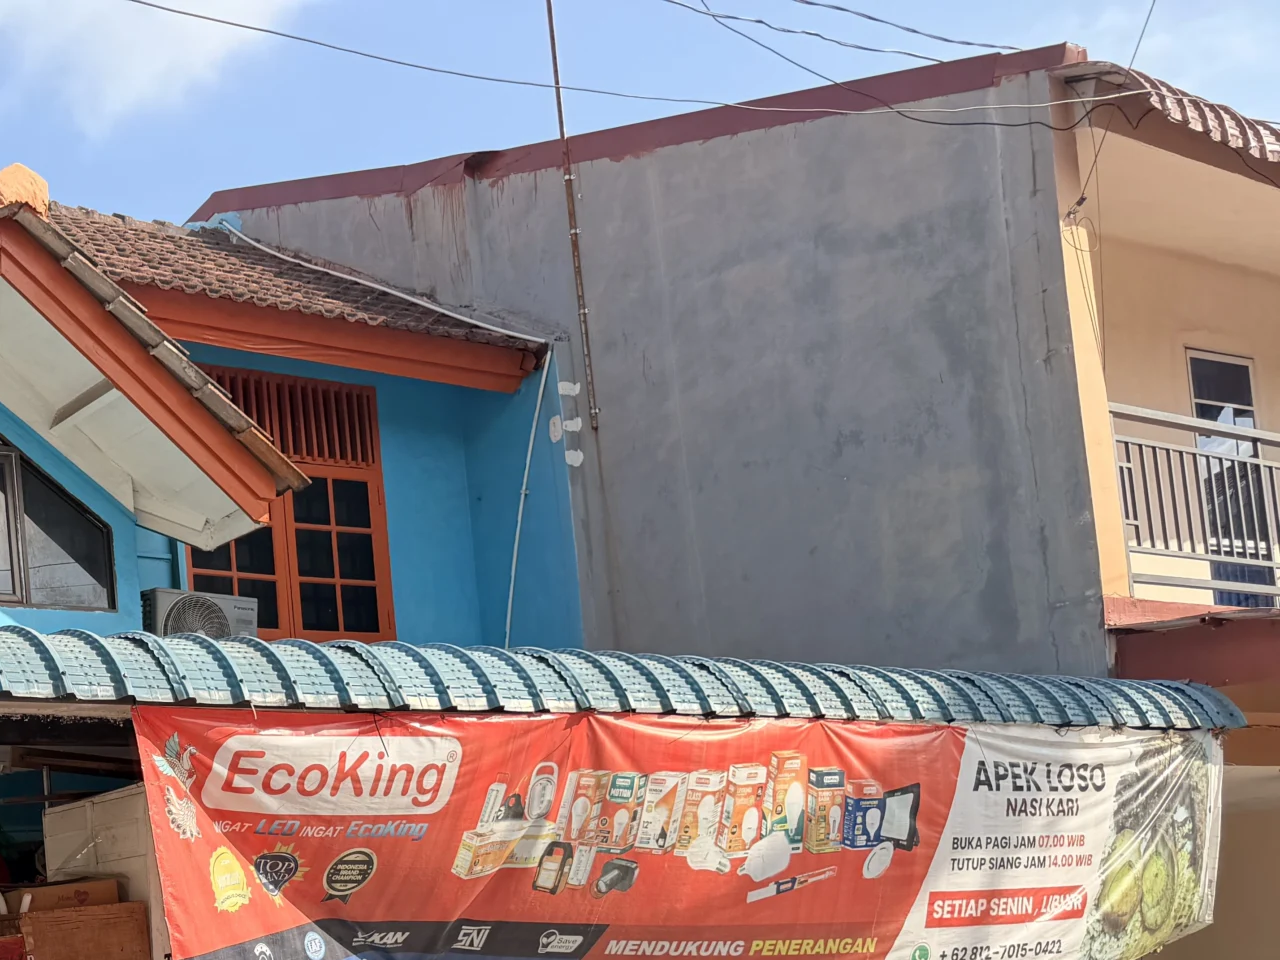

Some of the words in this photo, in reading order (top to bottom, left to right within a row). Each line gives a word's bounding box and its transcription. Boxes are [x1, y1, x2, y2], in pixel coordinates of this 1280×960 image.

[221, 750, 447, 808] EcoKing
[972, 760, 1042, 792] APEK
[1046, 763, 1106, 793] LOSO
[1006, 798, 1042, 817] NASI
[1046, 799, 1080, 816] KARI
[254, 819, 300, 837] LED
[299, 825, 343, 838] INGAT
[346, 820, 428, 842] EcoKing
[952, 837, 982, 850] BUKA
[985, 837, 1011, 850] PAGI
[1013, 836, 1036, 849] JAM
[1038, 835, 1065, 848] 07.00
[1067, 835, 1085, 847] WIB
[257, 858, 294, 872] TOP
[951, 858, 987, 871] TUTUP
[989, 857, 1021, 870] SIANG
[1024, 856, 1046, 869] JAM
[1048, 855, 1074, 868] 14.00
[1075, 854, 1093, 867] WIB
[933, 899, 986, 919] SETIAP
[371, 932, 409, 944] KAN
[453, 927, 491, 949] SNI
[557, 937, 577, 945] Save
[604, 940, 745, 956] MENDUKUNG
[749, 937, 877, 956] PENERANGAN
